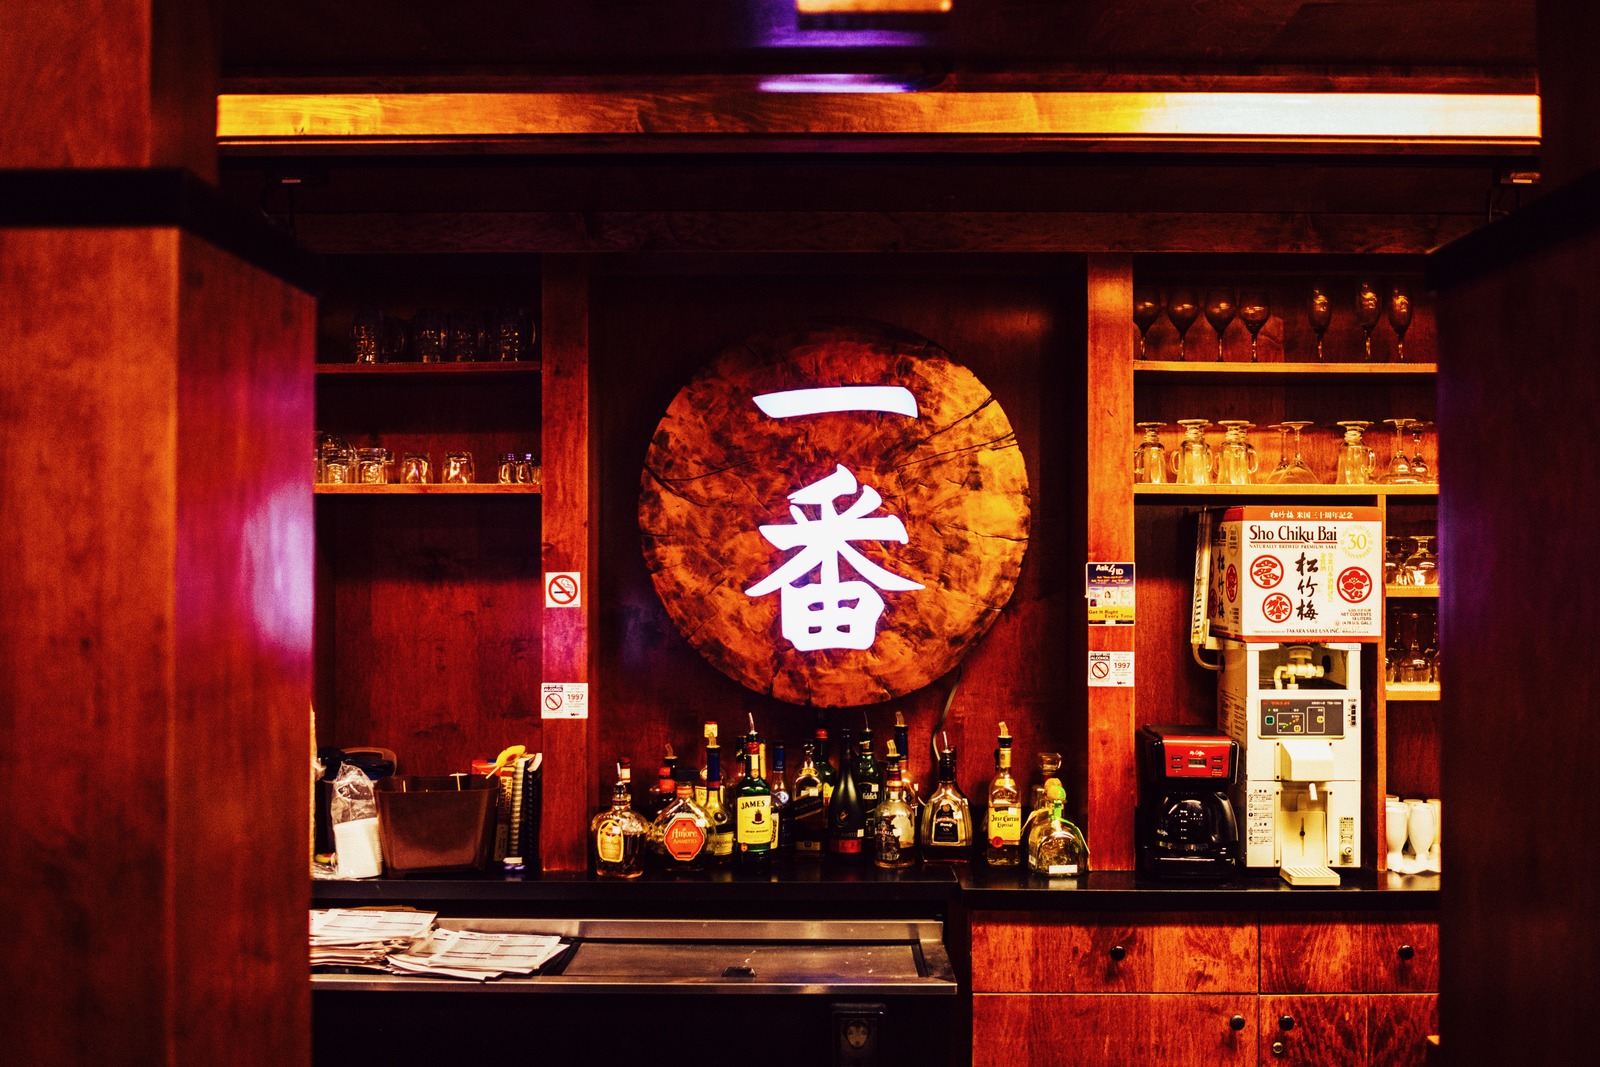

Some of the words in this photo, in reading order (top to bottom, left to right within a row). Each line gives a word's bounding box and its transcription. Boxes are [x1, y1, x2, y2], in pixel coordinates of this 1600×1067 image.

[745, 386, 925, 651] 一番
[1249, 525, 1274, 540] Sho
[1278, 525, 1314, 543] Chiku
[1318, 526, 1337, 540] Bai
[1347, 533, 1367, 550] 30
[1108, 564, 1115, 575] 4
[1295, 552, 1319, 620] 松竹梅
[741, 800, 766, 810] JAMES
[991, 814, 1003, 822] Jose
[1003, 814, 1020, 822] Cuervo
